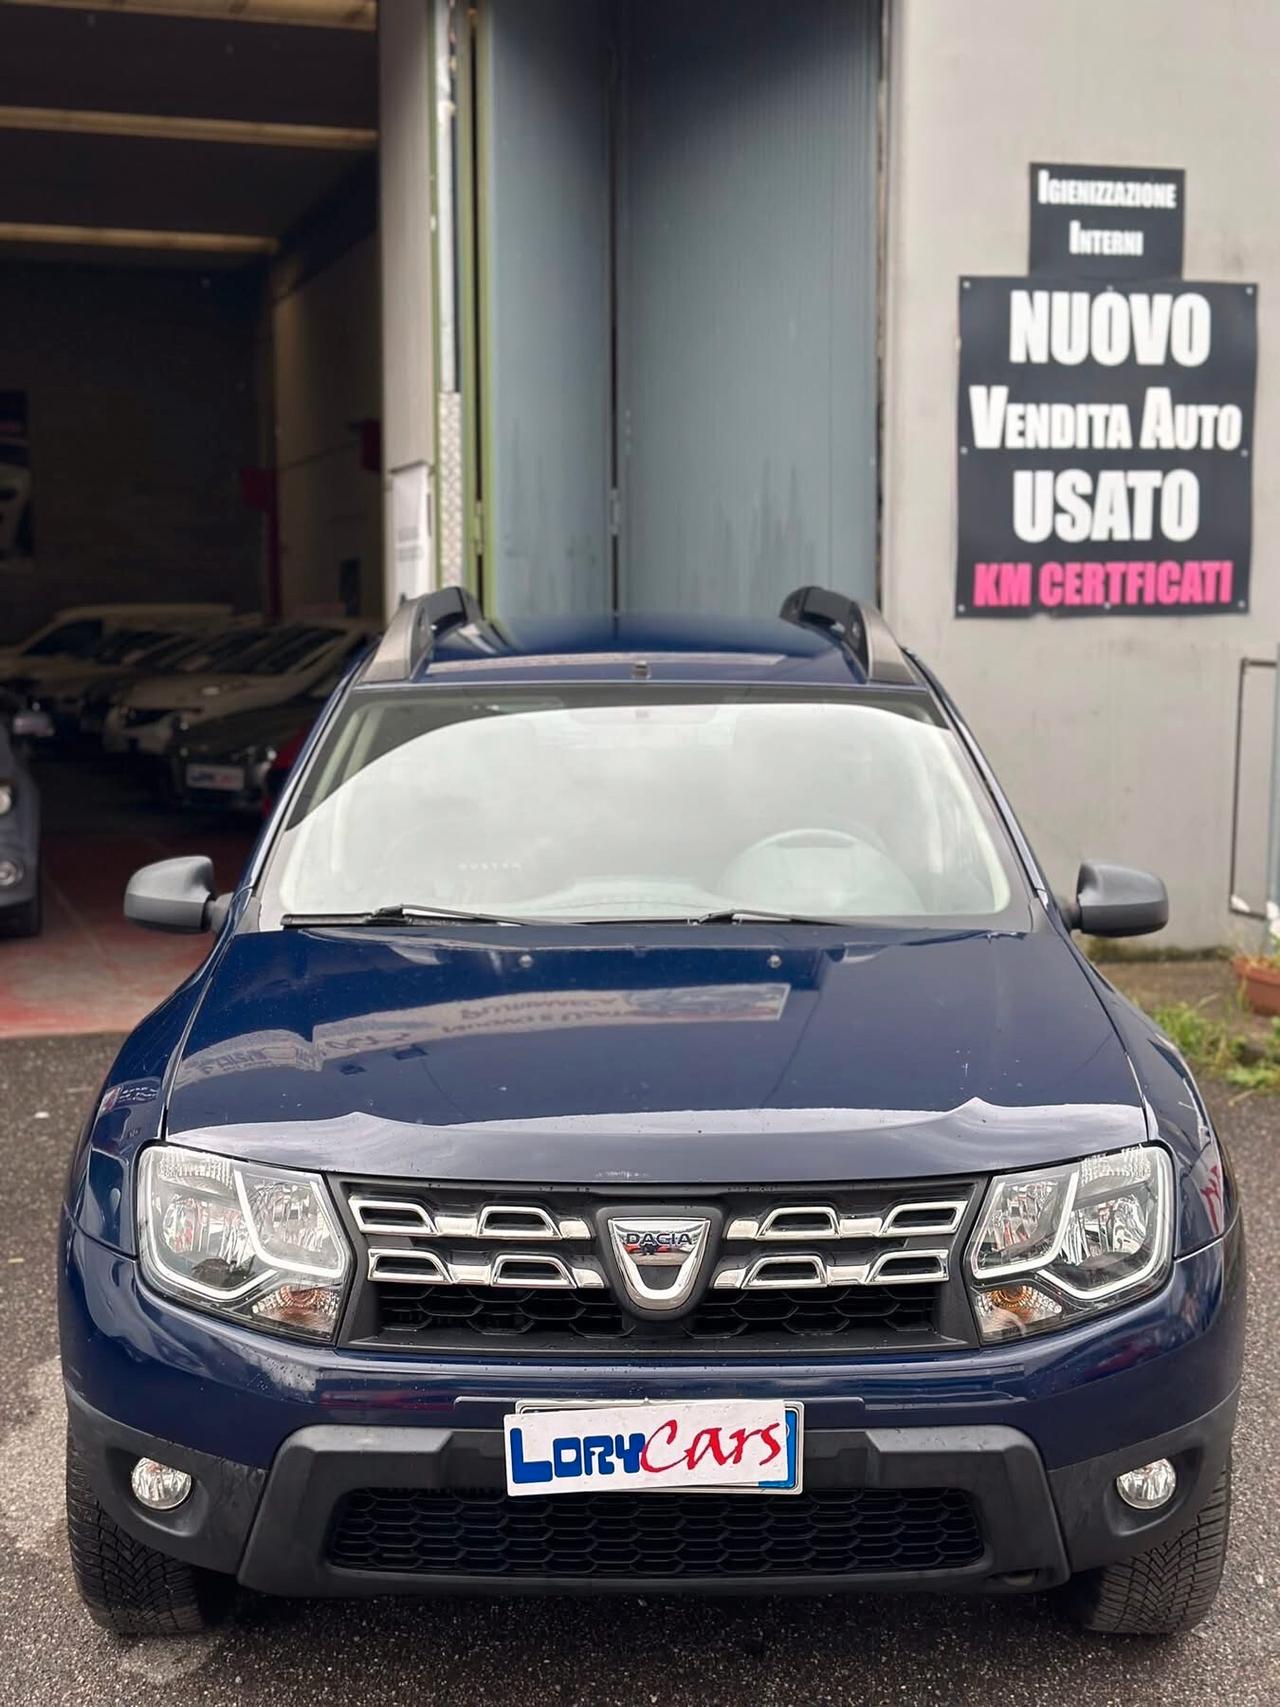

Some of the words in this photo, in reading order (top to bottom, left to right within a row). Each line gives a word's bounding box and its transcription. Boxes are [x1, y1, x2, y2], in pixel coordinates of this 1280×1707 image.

[1037, 169, 1177, 209] IGIENIZZAZIONE
[1069, 220, 1144, 256] INTERNI
[1009, 290, 1212, 367] NUOVO
[969, 384, 1133, 450] VENDITA
[1139, 386, 1243, 451] AUTO
[1013, 468, 1200, 543] USATO
[973, 562, 1032, 608] KM
[1038, 560, 1234, 606] CERTFICATI
[626, 1233, 693, 1246] DACIA
